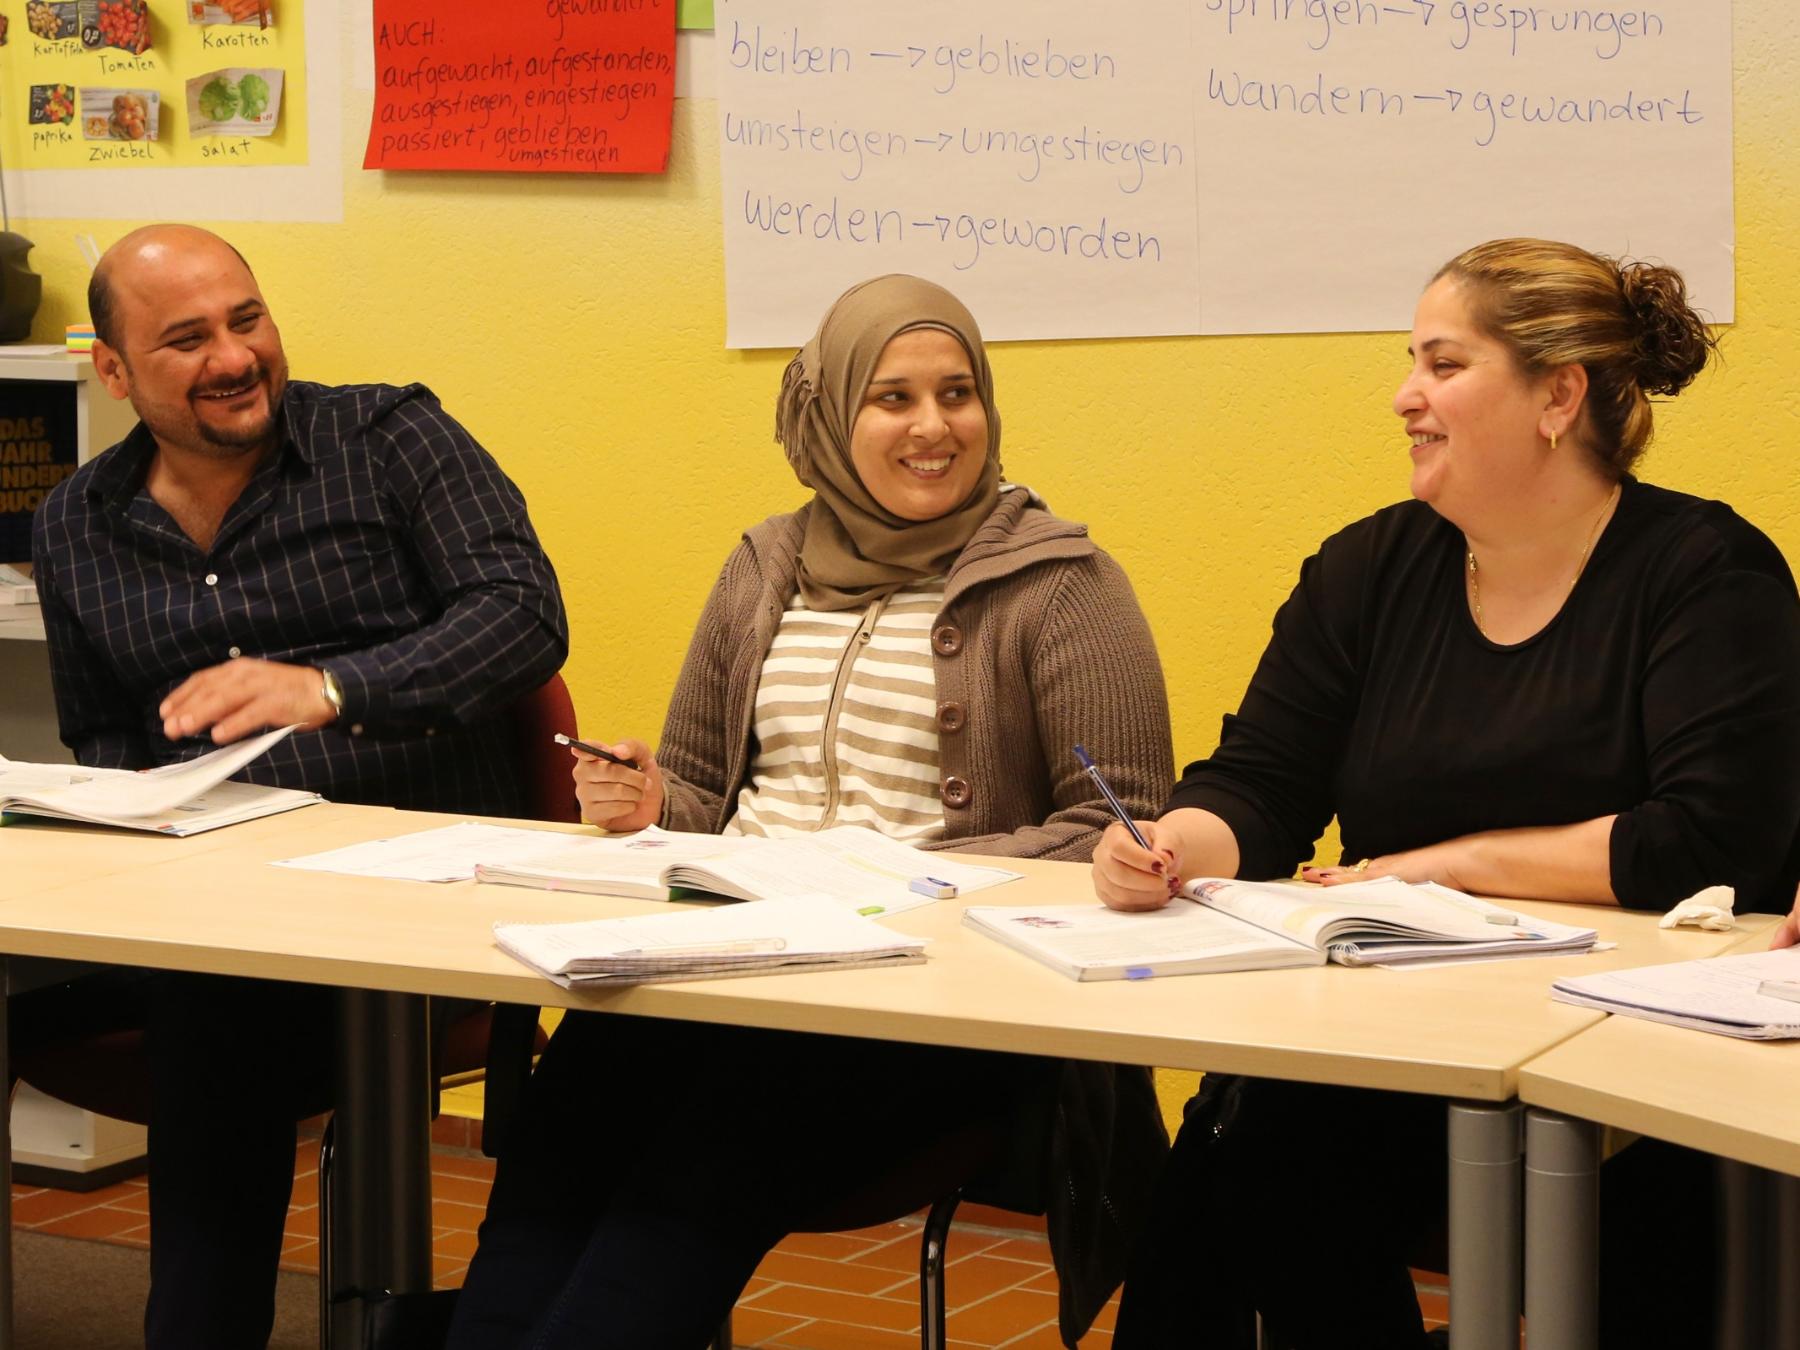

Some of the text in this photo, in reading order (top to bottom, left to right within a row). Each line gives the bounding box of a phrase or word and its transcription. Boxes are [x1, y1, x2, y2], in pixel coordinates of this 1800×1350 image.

[202, 31, 270, 49] Karotten
[379, 18, 446, 50] AUCH:
[547, 0, 661, 41] gewan
[1450, 0, 1663, 59] gesprungen
[382, 46, 672, 99] aufgewacht, aufgestanden,
[730, 20, 1116, 94] bleiben geblieben
[381, 79, 657, 129] ausgestiegen, eingestiegen
[1473, 89, 1705, 146] gewandert
[380, 114, 608, 163] passiert, geblieben
[509, 145, 619, 171] umgestiegen
[726, 109, 1183, 193] umsteigen umgestiegen
[953, 216, 1161, 270] geworden
[0, 441, 54, 464] AHR
